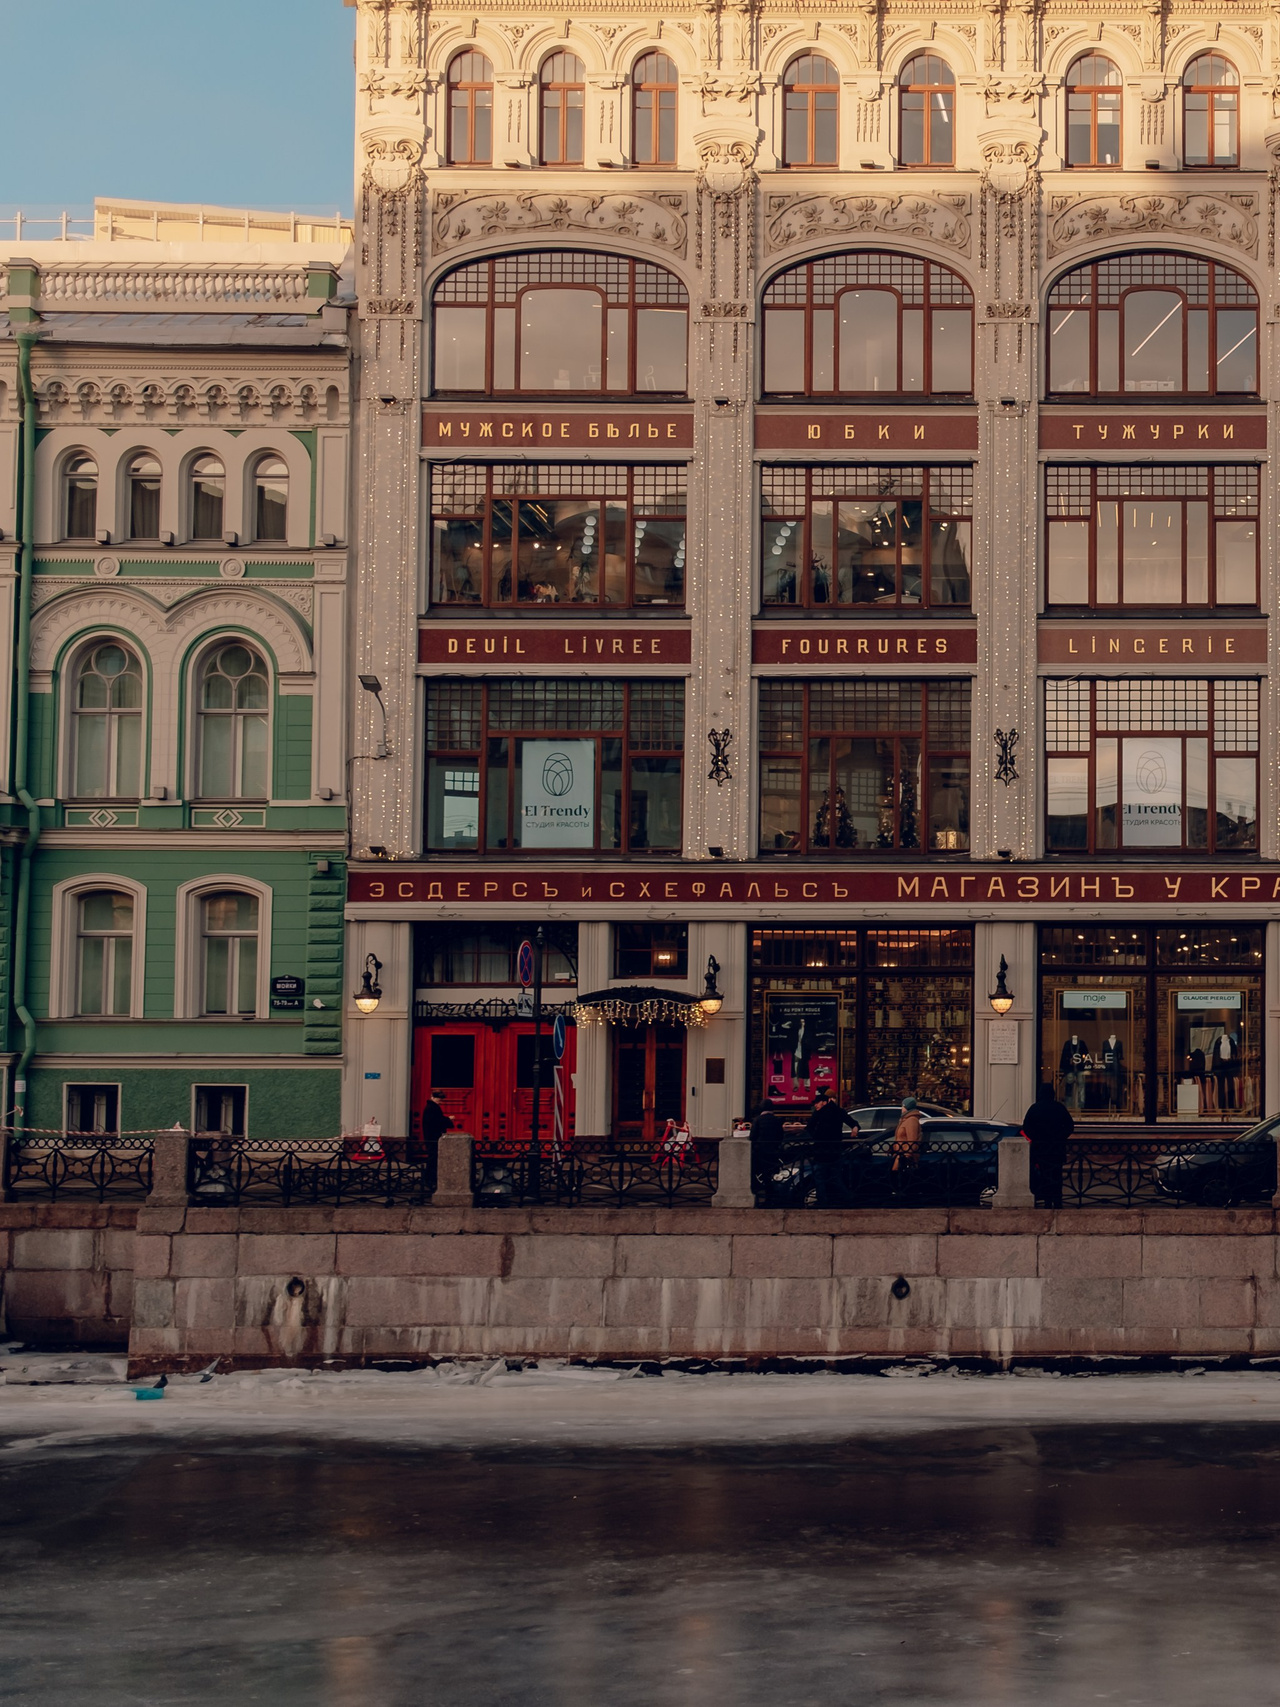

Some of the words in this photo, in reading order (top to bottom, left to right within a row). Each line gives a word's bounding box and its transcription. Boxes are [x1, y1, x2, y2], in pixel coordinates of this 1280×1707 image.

[439, 422, 570, 438] МУЖСКОЕ
[807, 424, 926, 440] ЮБКИ
[1072, 424, 1235, 440] ТУЖУРКИ
[782, 638, 948, 654] FOURRURES
[525, 805, 538, 817] El
[541, 804, 591, 819] Trendy
[526, 821, 555, 829] СТУДИЯ
[556, 821, 590, 829] КРАСОТЫ
[369, 882, 559, 899] ЭСДЕРСЪ
[609, 882, 849, 898] СХЕФАЛЬСЪ
[898, 876, 1135, 898] МАГАЗИНЪ
[1164, 876, 1182, 898] У
[1082, 993, 1107, 1003] maje
[1072, 1052, 1115, 1064] SALE
